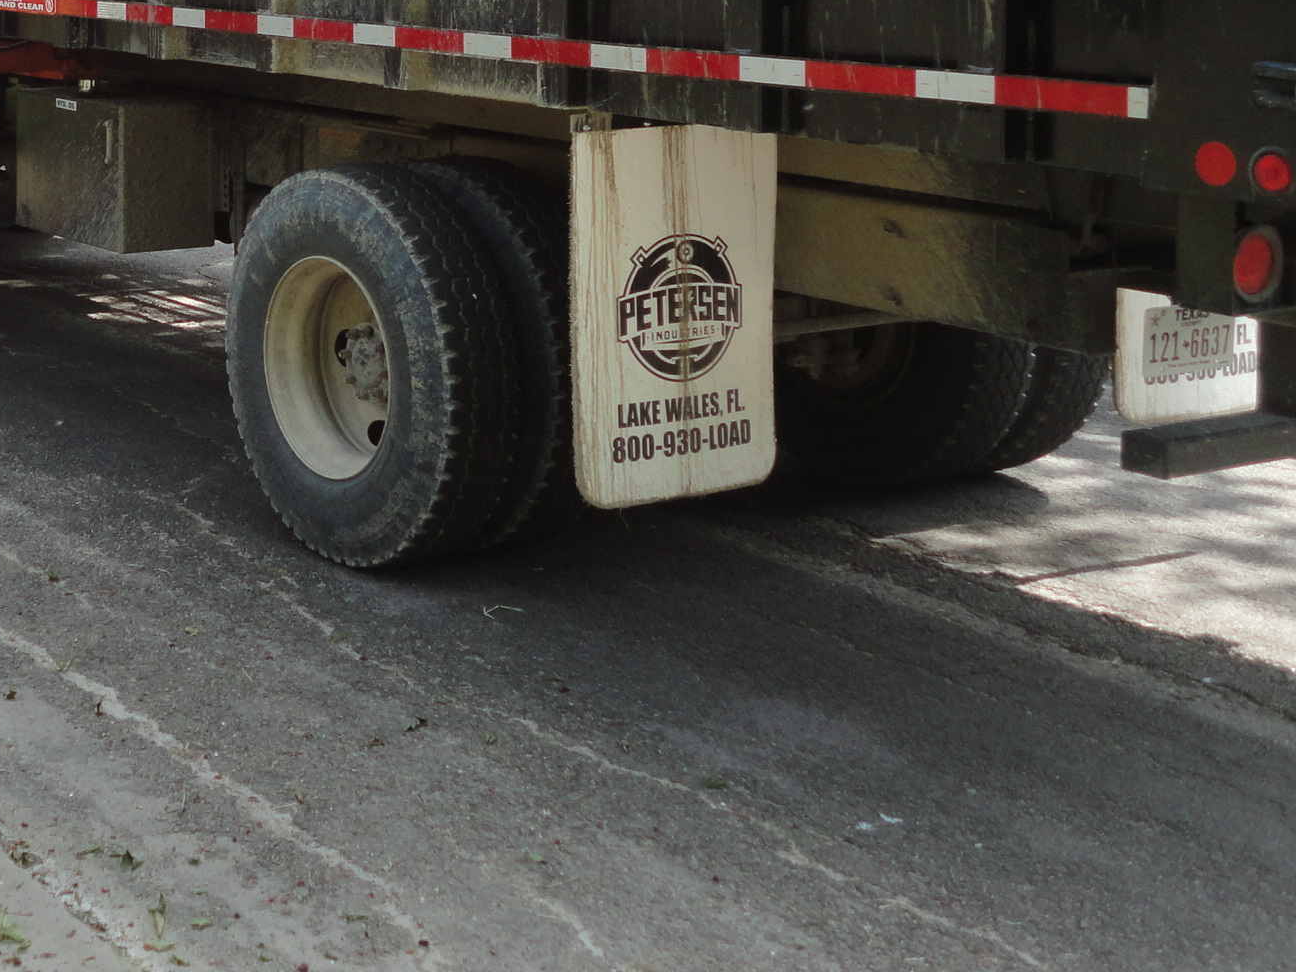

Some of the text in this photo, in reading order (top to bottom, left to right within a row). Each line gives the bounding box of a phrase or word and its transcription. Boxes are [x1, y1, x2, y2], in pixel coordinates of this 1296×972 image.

[17, 2, 44, 11] CLEAR
[620, 286, 740, 337] PETERSEN
[617, 388, 745, 428] LAKE WALES, FL.
[612, 419, 751, 464] 800-930-LOAD
